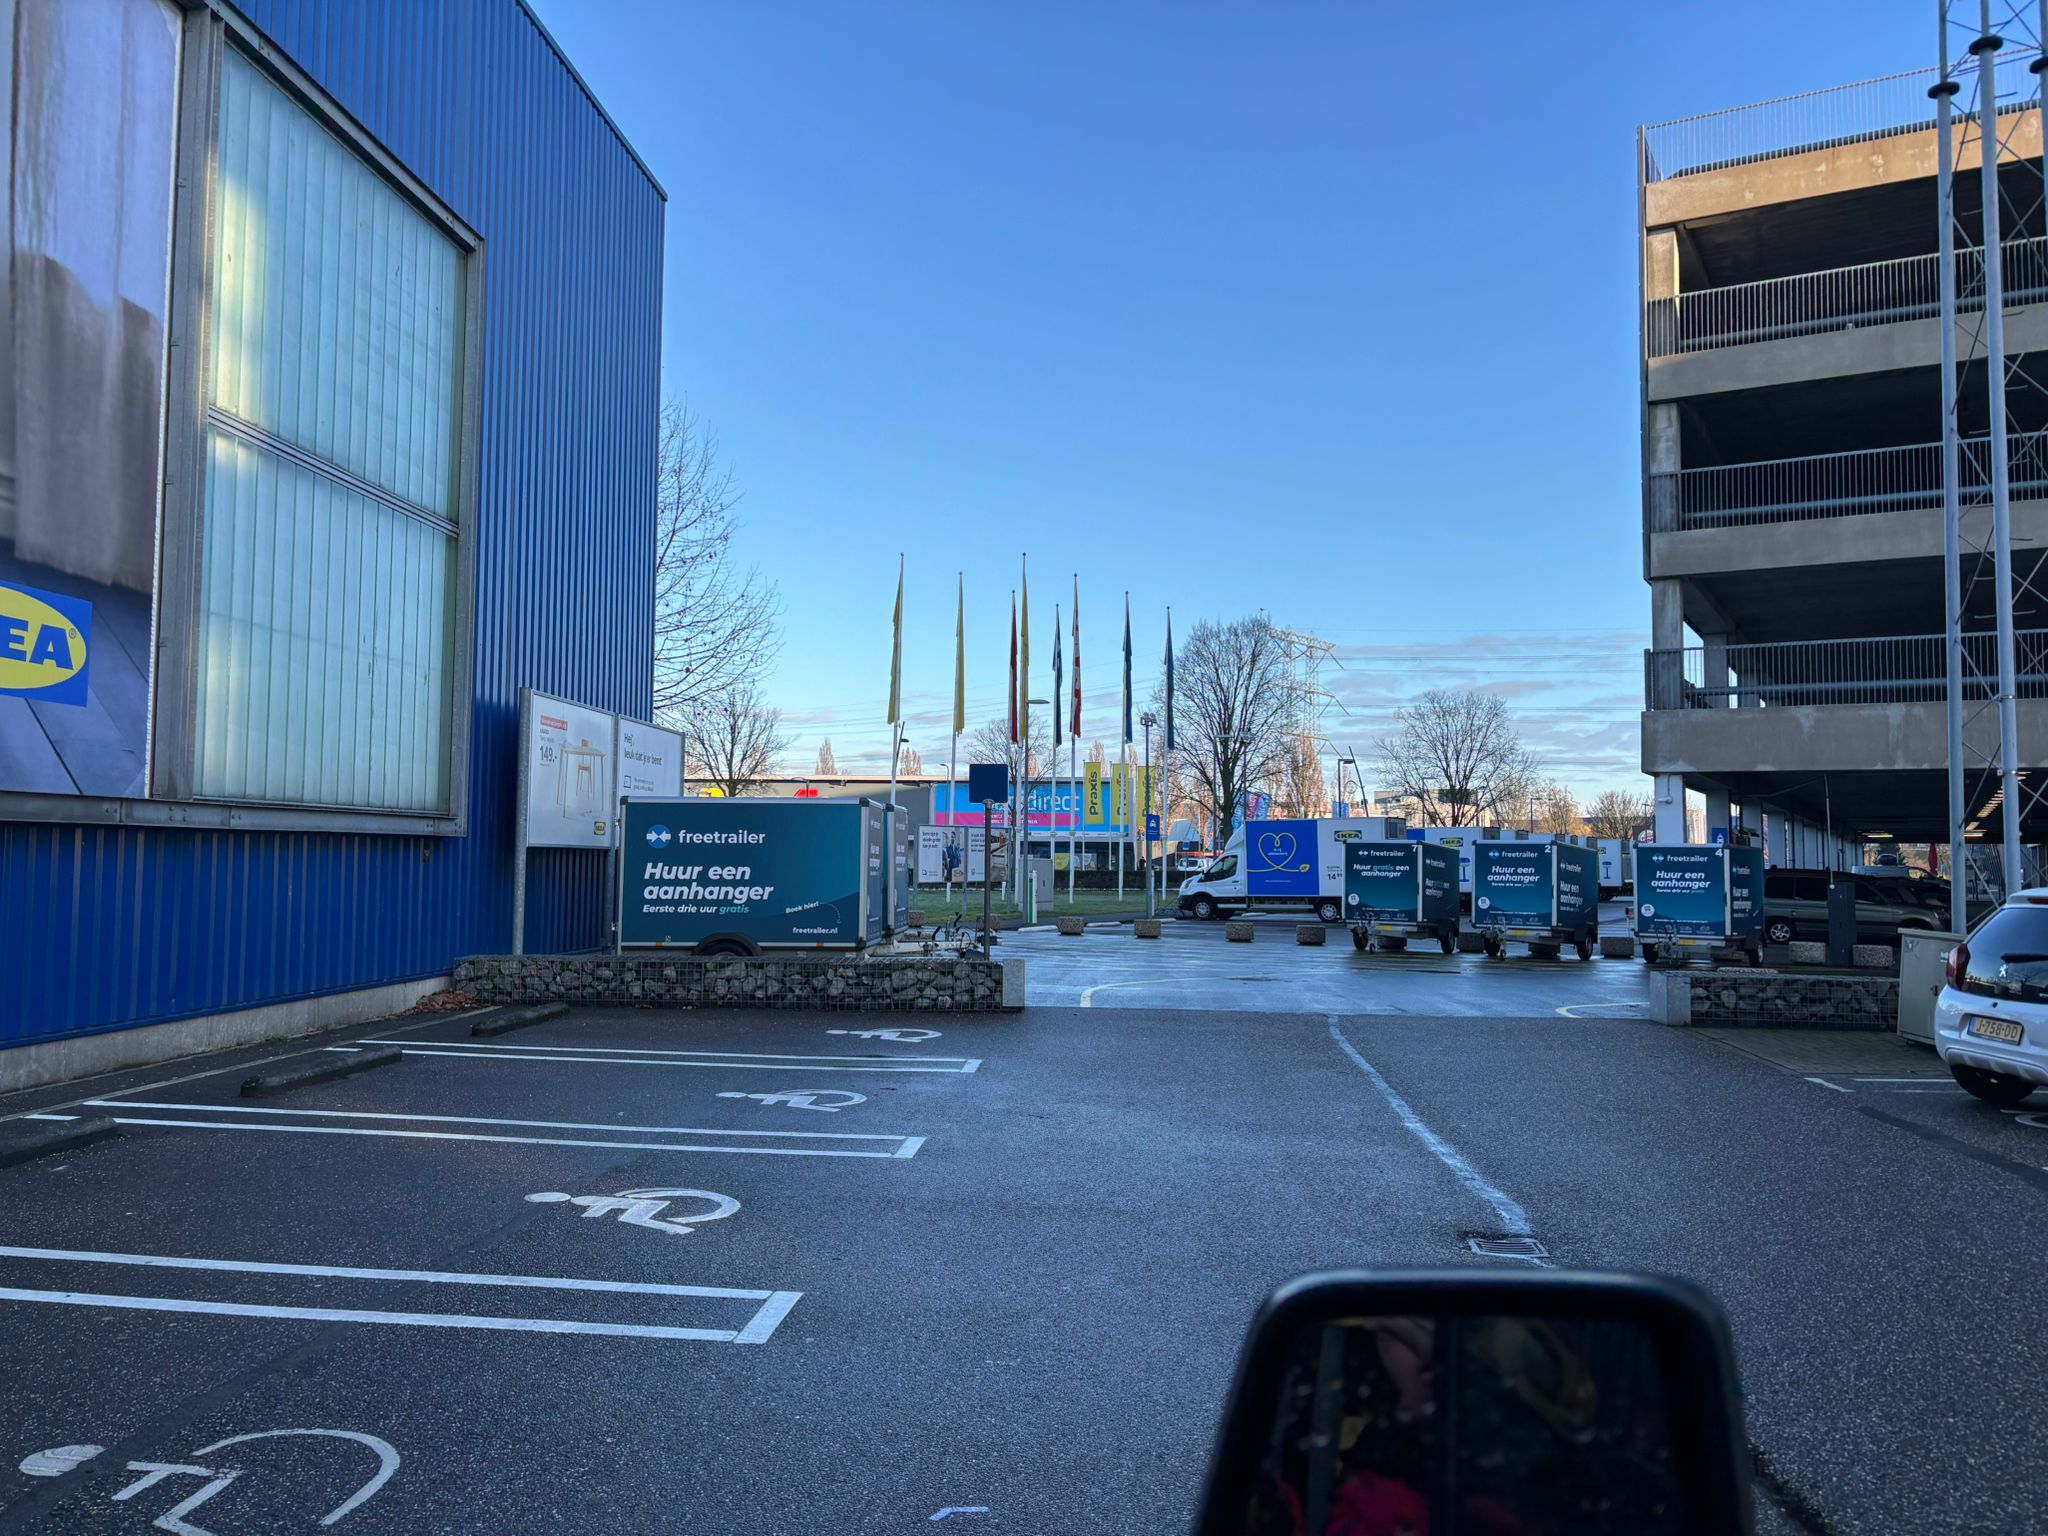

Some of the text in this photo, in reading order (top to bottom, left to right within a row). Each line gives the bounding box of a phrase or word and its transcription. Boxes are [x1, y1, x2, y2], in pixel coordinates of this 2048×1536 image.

[1088, 771, 1099, 816] Praxis
[678, 829, 766, 844] freetrailer
[1411, 844, 1417, 852] 7
[1544, 845, 1551, 853] 2
[1715, 849, 1723, 857] 4
[644, 862, 751, 880] Huur een
[1372, 864, 1394, 872] gratis
[1492, 866, 1515, 874] Huur
[1487, 874, 1540, 883] aanhanger
[1656, 871, 1683, 879] Huur
[1651, 880, 1711, 889] aanhanger
[643, 882, 774, 904] aanhanger
[642, 904, 750, 915] Eerste drie uur gratis
[785, 905, 803, 914] Boek
[792, 926, 838, 934] freetrailer.nl
[1976, 1019, 2018, 1039] J-758-DD
